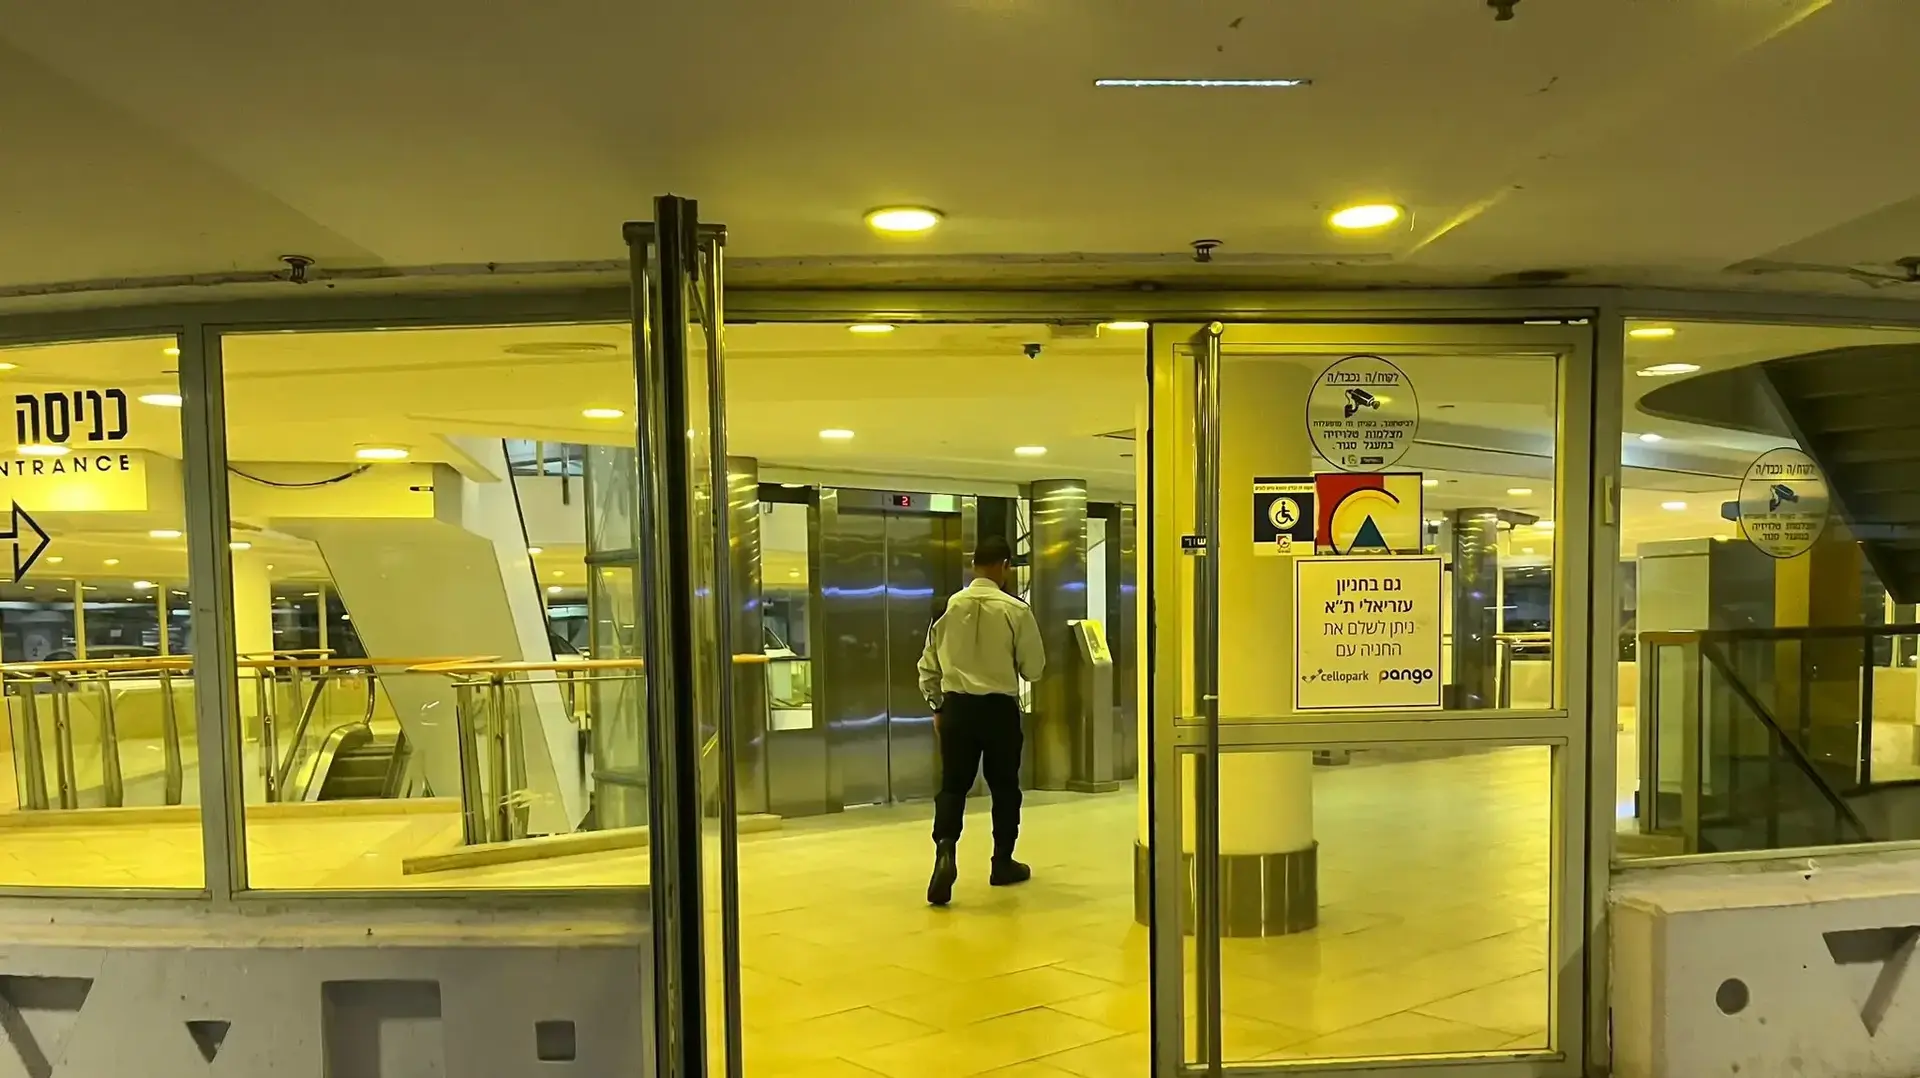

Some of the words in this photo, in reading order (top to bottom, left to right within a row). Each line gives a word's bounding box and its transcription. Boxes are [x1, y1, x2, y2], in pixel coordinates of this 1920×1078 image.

[1327, 371, 1360, 383] נכבד/ה
[15, 388, 128, 445] כניסה
[1323, 430, 1360, 439] טלויזיה
[1365, 430, 1403, 439] מצלמות
[1332, 441, 1357, 450] סגור.
[1363, 440, 1394, 450] במעגל
[0, 455, 129, 476] NTRANCE
[902, 496, 908, 505] 2
[1184, 538, 1206, 546] שוך
[1336, 578, 1379, 596] בחניון
[1383, 578, 1402, 592] גם
[1359, 598, 1413, 613] עזריאלי
[1323, 622, 1343, 635] את
[1348, 620, 1386, 635] לשלם
[1389, 620, 1414, 638] ניתן
[1336, 643, 1356, 657] עם
[1361, 643, 1402, 656] החניה
[1320, 670, 1369, 683] cellopark
[1378, 669, 1433, 684] pango
